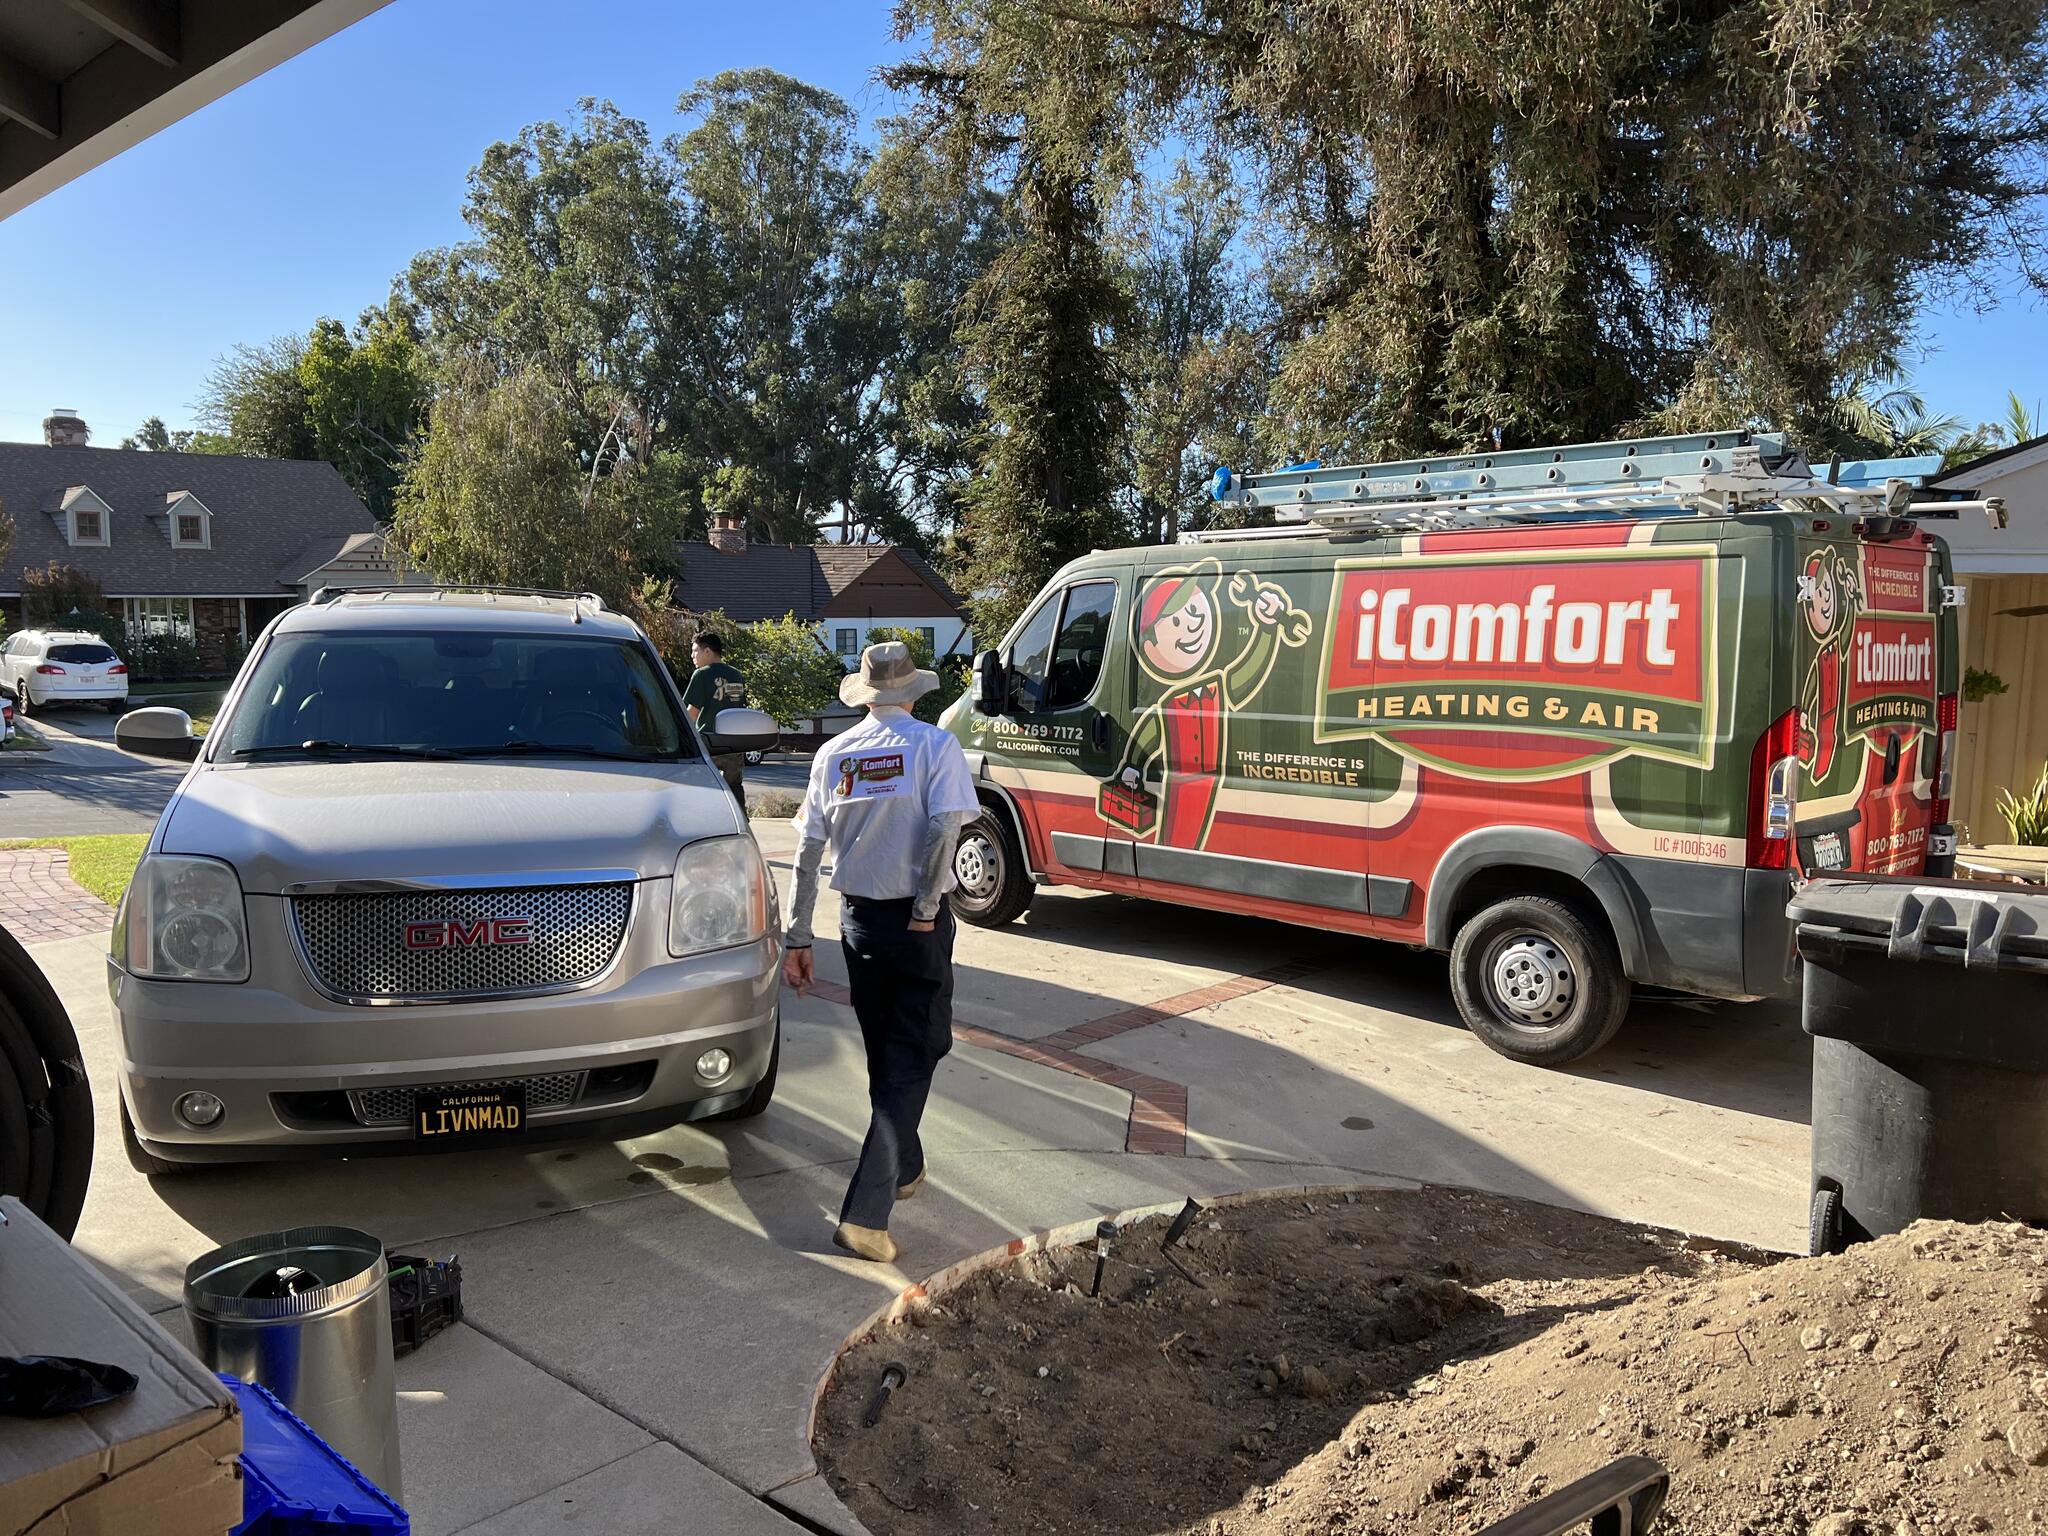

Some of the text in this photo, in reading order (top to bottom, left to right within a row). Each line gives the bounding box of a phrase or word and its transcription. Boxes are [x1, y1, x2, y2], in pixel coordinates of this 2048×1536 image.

[1868, 567, 1919, 582] THE DIFFERENCE IS
[1872, 581, 1918, 598] INCREDIBLE
[1357, 584, 1680, 666] iComfort
[1857, 632, 1931, 683] iComfort
[1357, 694, 1660, 734] HEATING & AIR
[1856, 701, 1927, 724] HEATING & AIR
[996, 741, 1080, 756] CALICOMFORT.COM
[862, 757, 901, 771] iComfort
[1236, 751, 1365, 769] THE DIFFERENCE IS
[1242, 764, 1359, 787] INCREDIBLE
[1654, 837, 1727, 858] LIC #1006346
[404, 917, 533, 949] GMC
[442, 1095, 500, 1106] CALIFORNIA
[421, 1105, 519, 1135] LIVNMAD
